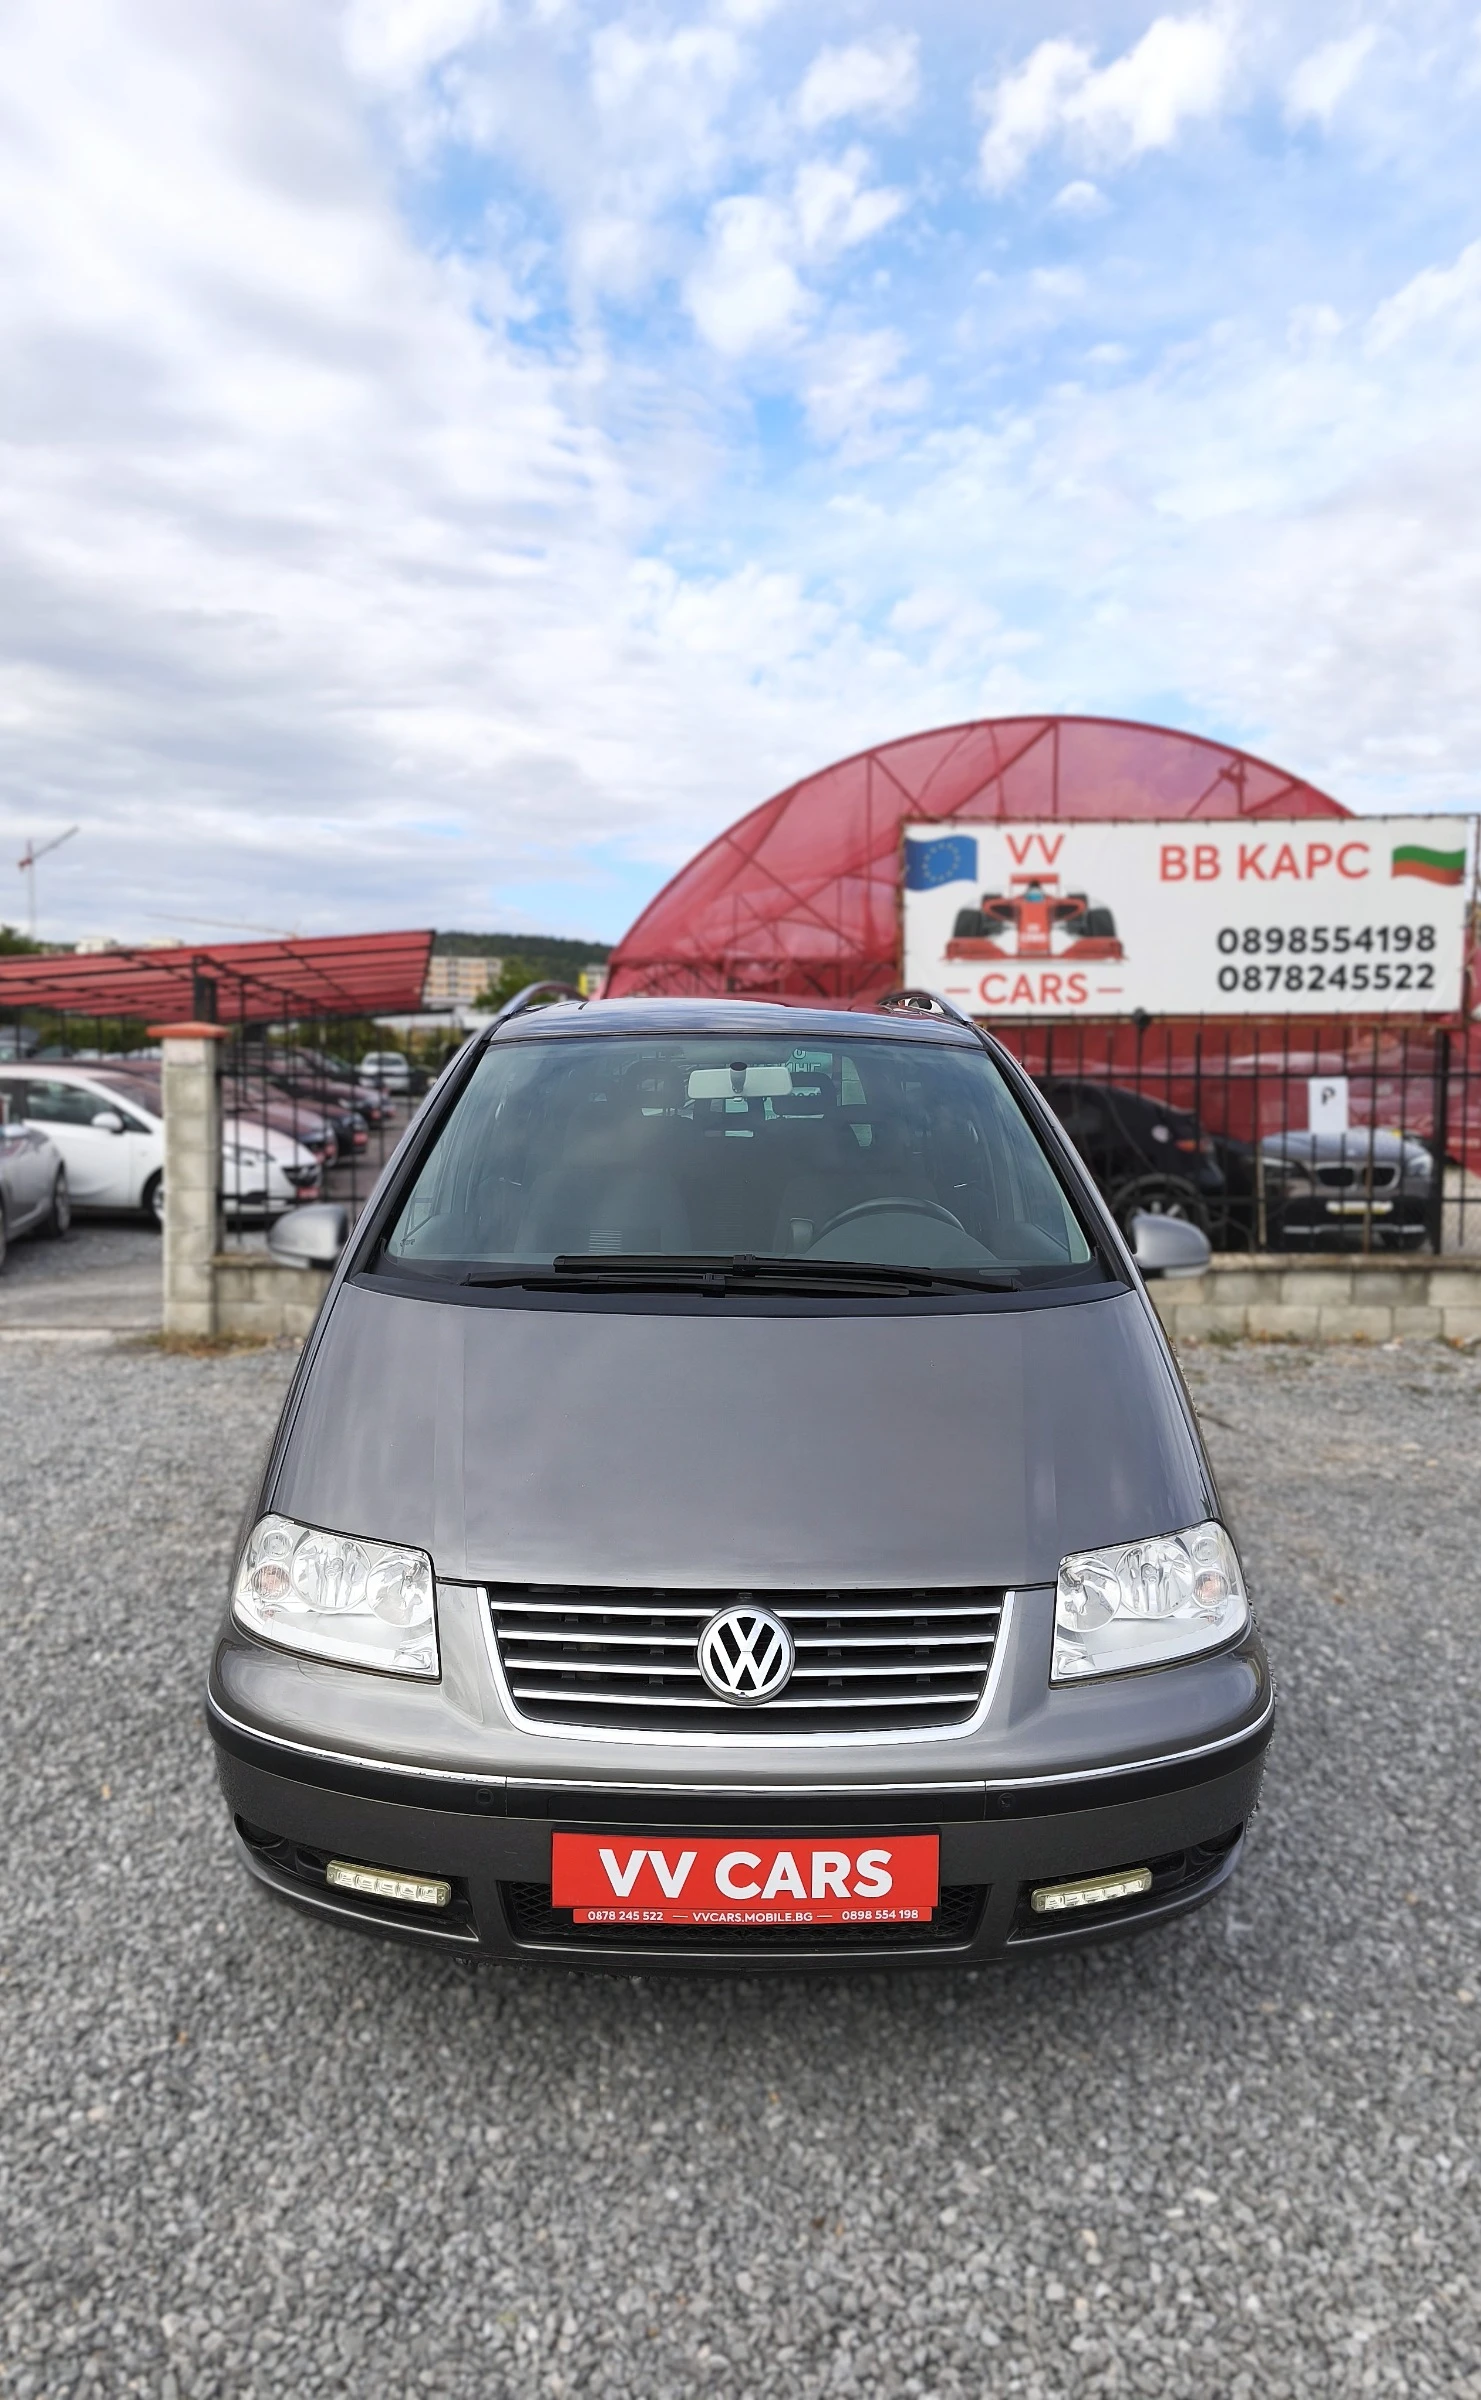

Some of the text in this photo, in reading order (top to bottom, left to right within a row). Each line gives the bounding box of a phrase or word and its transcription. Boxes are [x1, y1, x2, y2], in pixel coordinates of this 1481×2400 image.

[1006, 834, 1064, 866] VV
[1160, 841, 1369, 883] ВВ КАРС
[1217, 925, 1436, 956] 0898554198
[978, 972, 1089, 1006] CARS
[1217, 962, 1435, 993] 0878245522
[697, 1606, 795, 1706] VW
[598, 1848, 893, 1900] VV CARS
[587, 1908, 919, 1923] 0878 245 522 VVCARS.MOBILE.BG 0898 554 198
